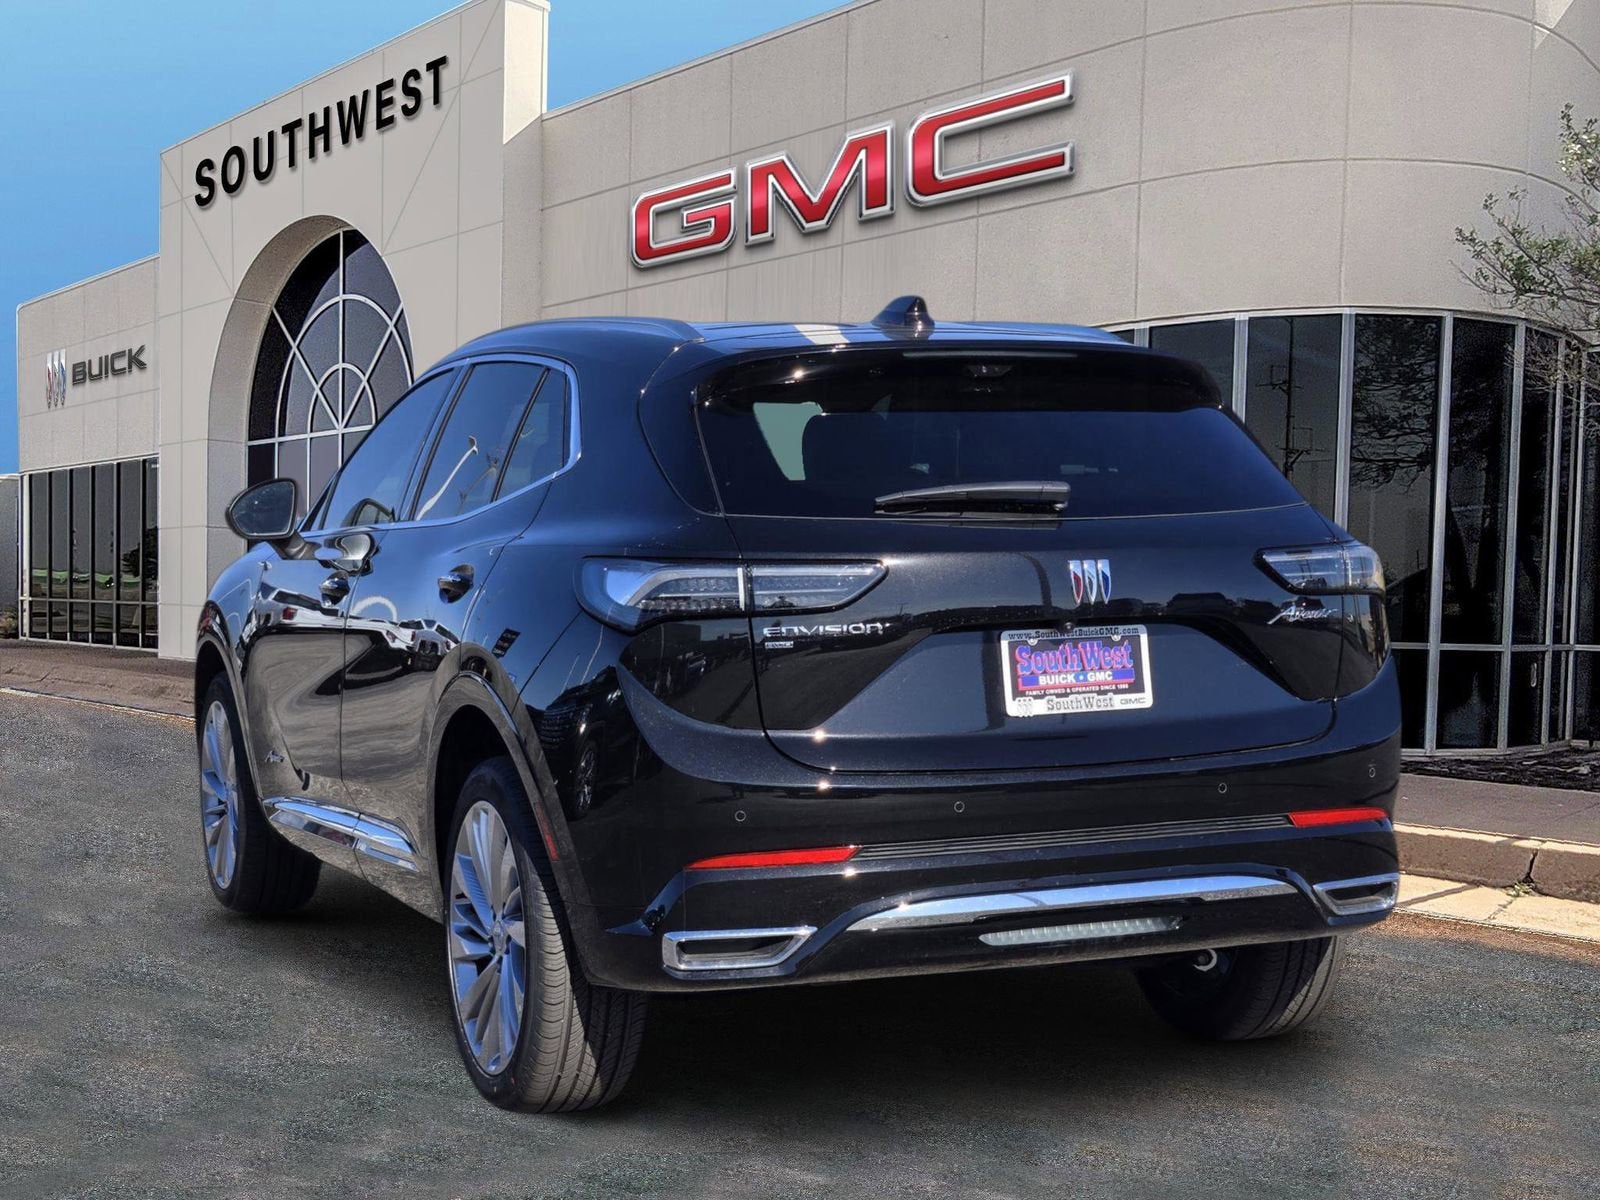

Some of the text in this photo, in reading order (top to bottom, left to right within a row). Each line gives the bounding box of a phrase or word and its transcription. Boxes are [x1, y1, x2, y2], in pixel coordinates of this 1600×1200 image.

[194, 55, 449, 207] SOUTHWEST
[630, 68, 1076, 268] GMC
[72, 344, 147, 386] BUICK
[1039, 670, 1113, 686] BUICK GMC
[1119, 697, 1146, 705] GMC
